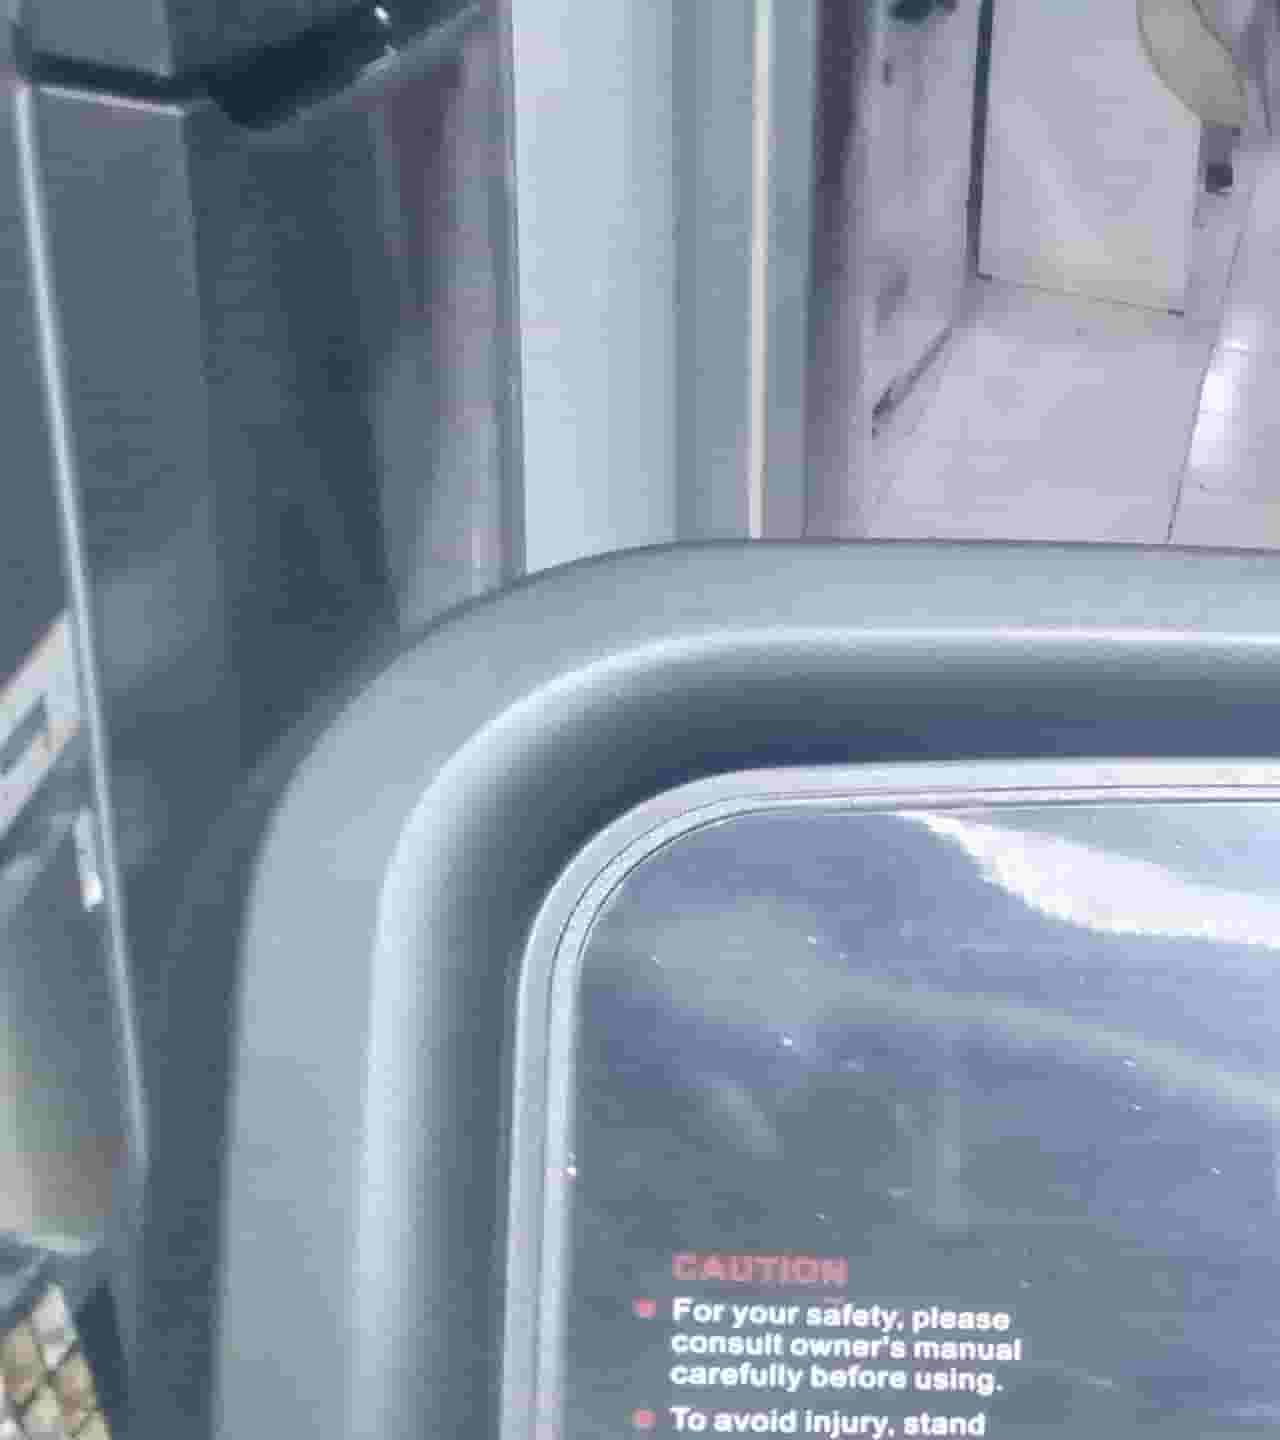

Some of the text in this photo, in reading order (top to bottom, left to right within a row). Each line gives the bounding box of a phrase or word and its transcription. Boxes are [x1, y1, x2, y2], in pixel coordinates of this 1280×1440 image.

[672, 1254, 848, 1283] CAUTION
[672, 1297, 1010, 1333] For your safety, please
[671, 1333, 1021, 1361] consult owner's manual
[670, 1363, 1004, 1396] carefully before using.
[669, 1407, 985, 1439] To avoid injury, stand
